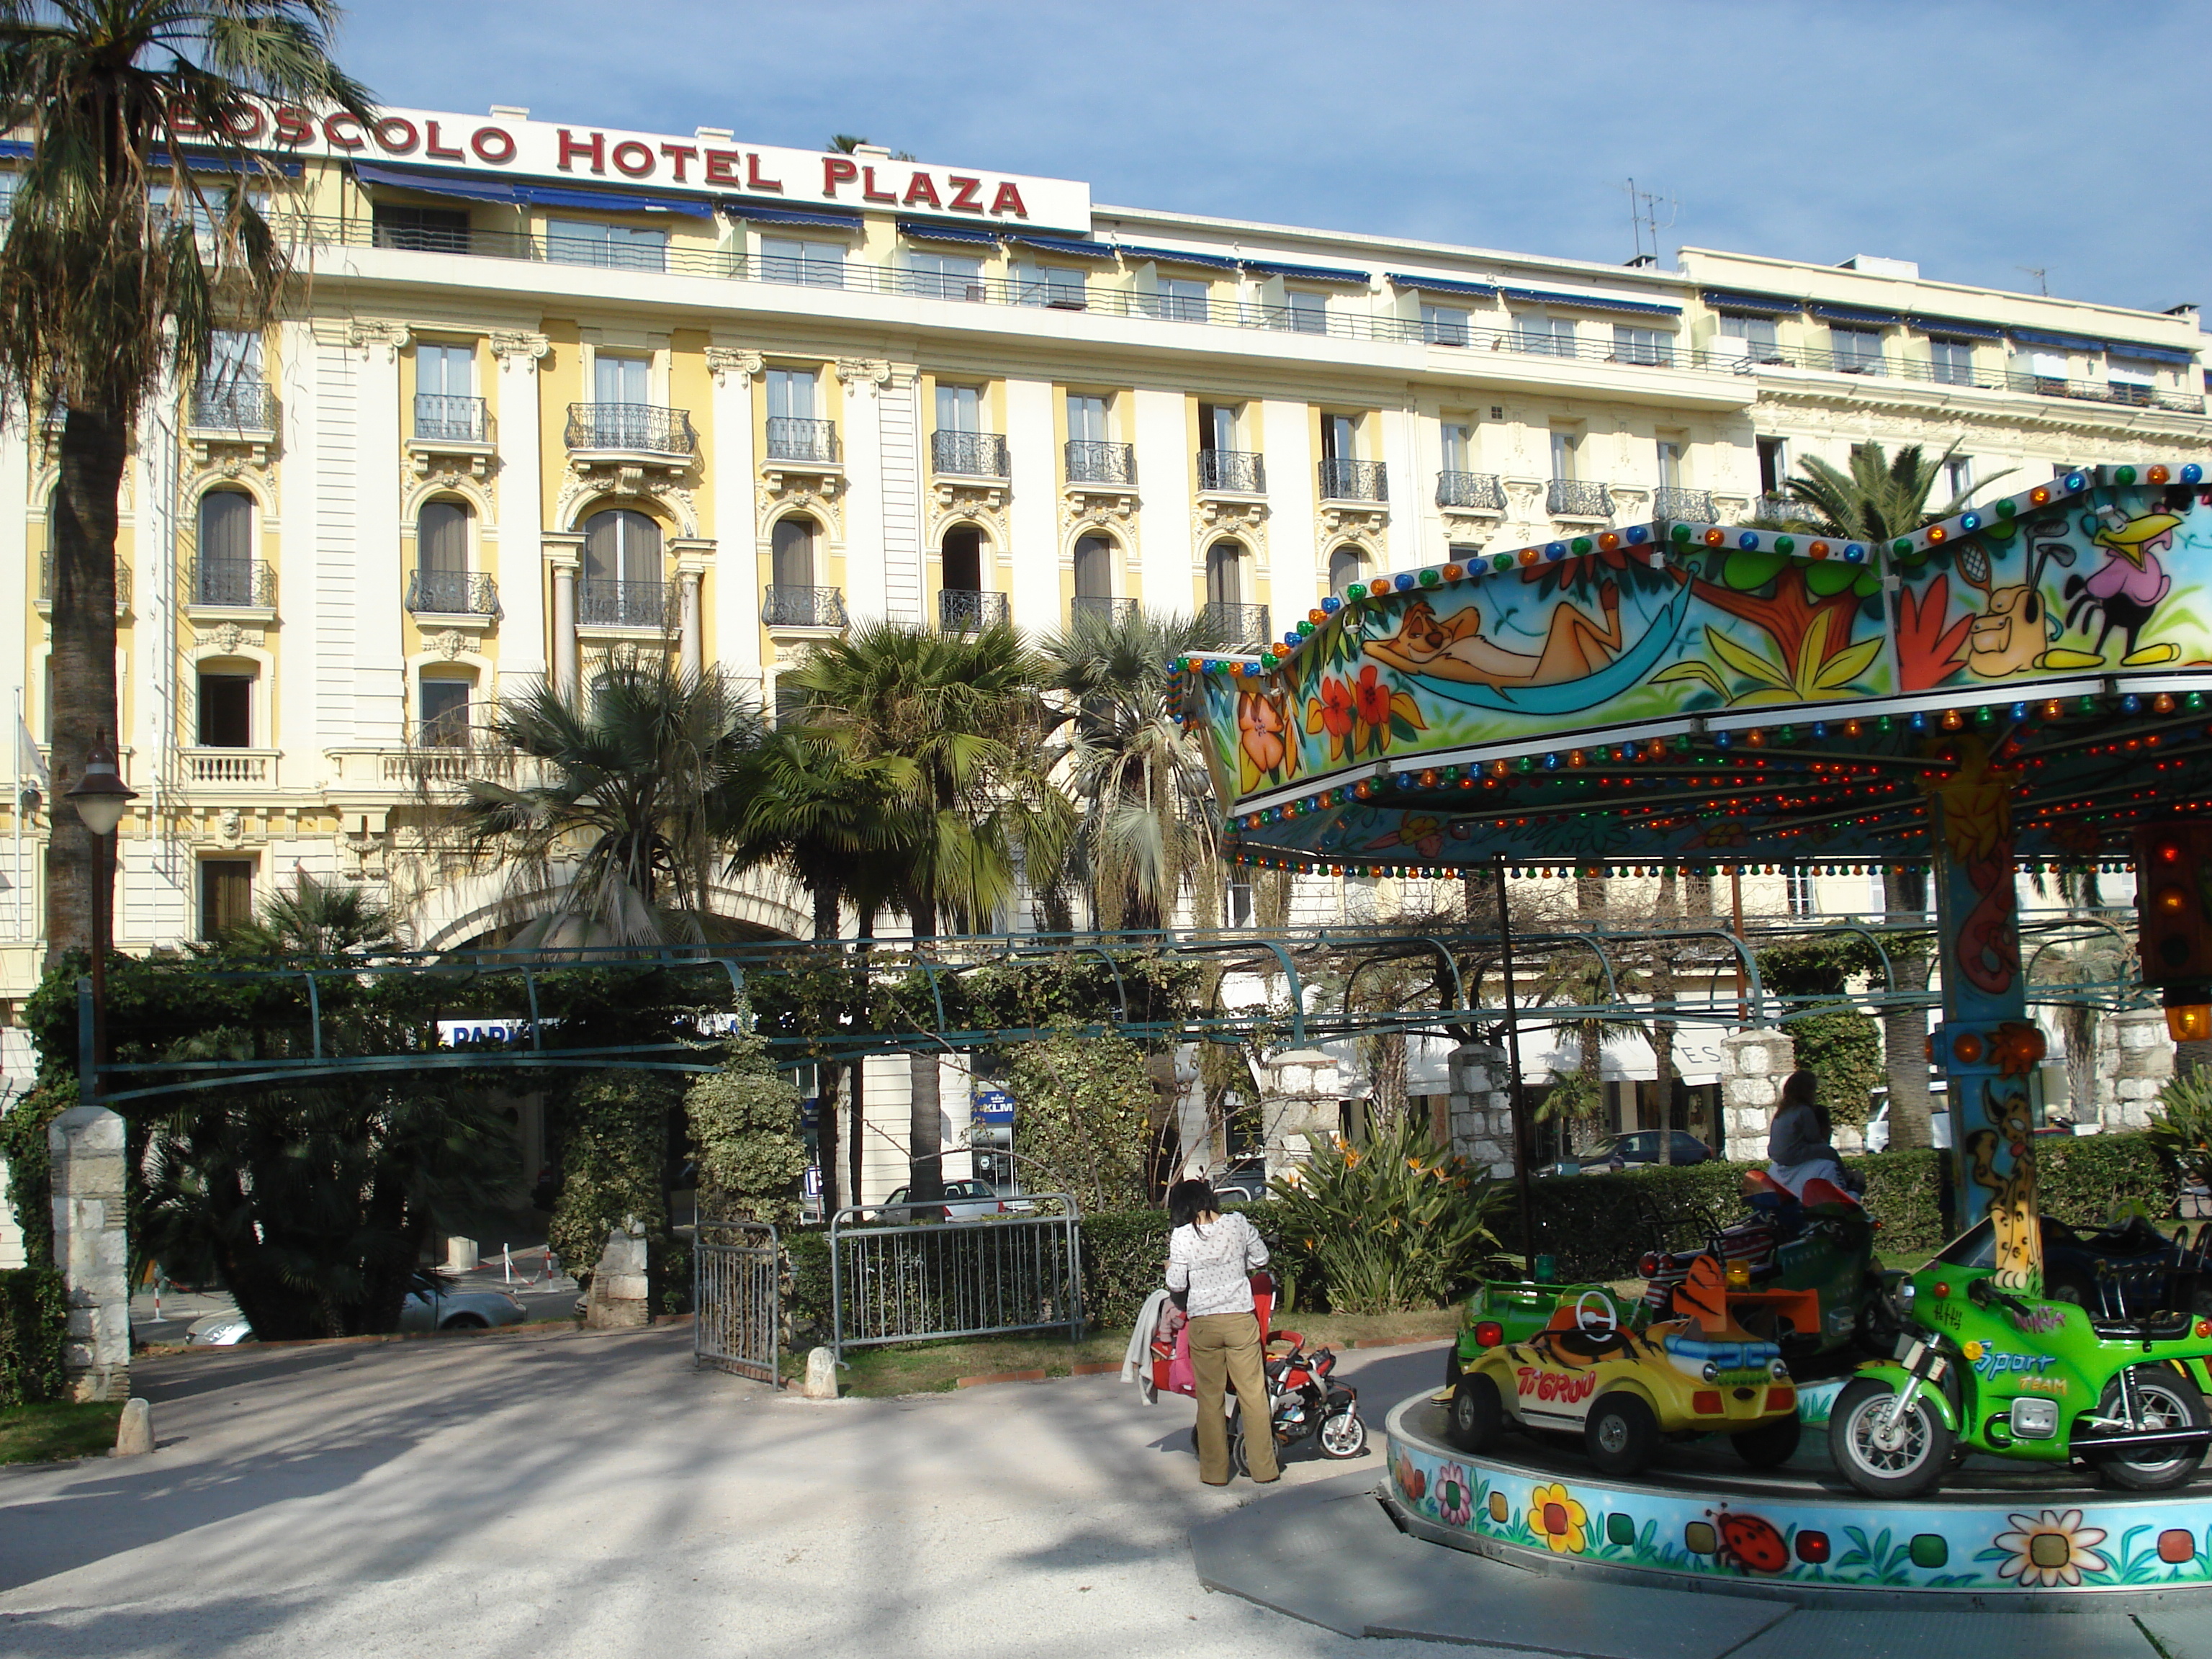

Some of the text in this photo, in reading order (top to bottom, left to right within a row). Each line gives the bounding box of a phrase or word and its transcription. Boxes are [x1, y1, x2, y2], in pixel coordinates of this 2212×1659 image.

[556, 127, 783, 192] HOTEL
[822, 156, 1029, 217] PLAZA
[984, 1103, 1013, 1112] KLM
[1974, 1339, 2056, 1381] Sport
[2018, 1376, 2068, 1396] TEAM
